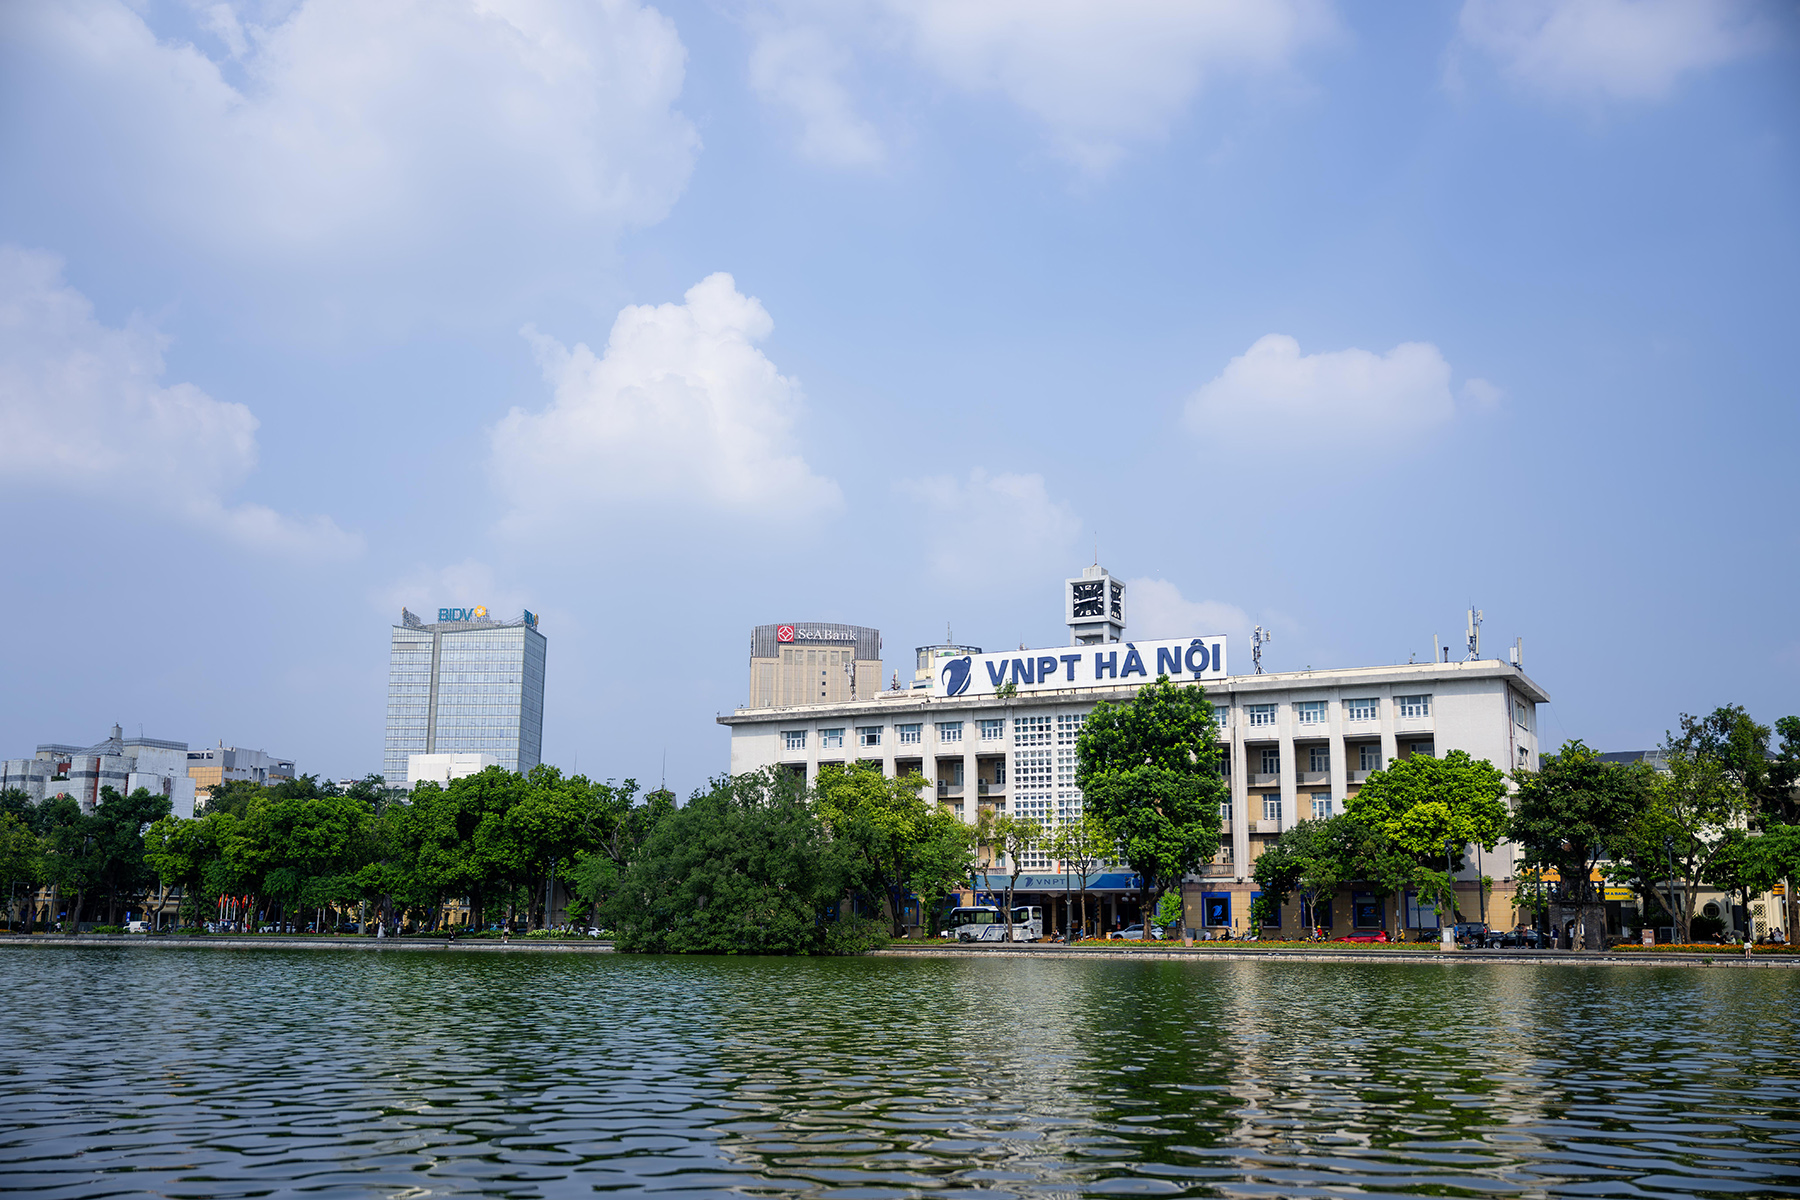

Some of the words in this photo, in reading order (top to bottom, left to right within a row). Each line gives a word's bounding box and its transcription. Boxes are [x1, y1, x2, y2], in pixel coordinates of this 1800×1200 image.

[438, 608, 474, 621] BIDV
[798, 628, 857, 641] SeABank
[986, 654, 1082, 686] VNPT
[1095, 642, 1147, 680] HÀ
[1157, 638, 1220, 680] NỘI
